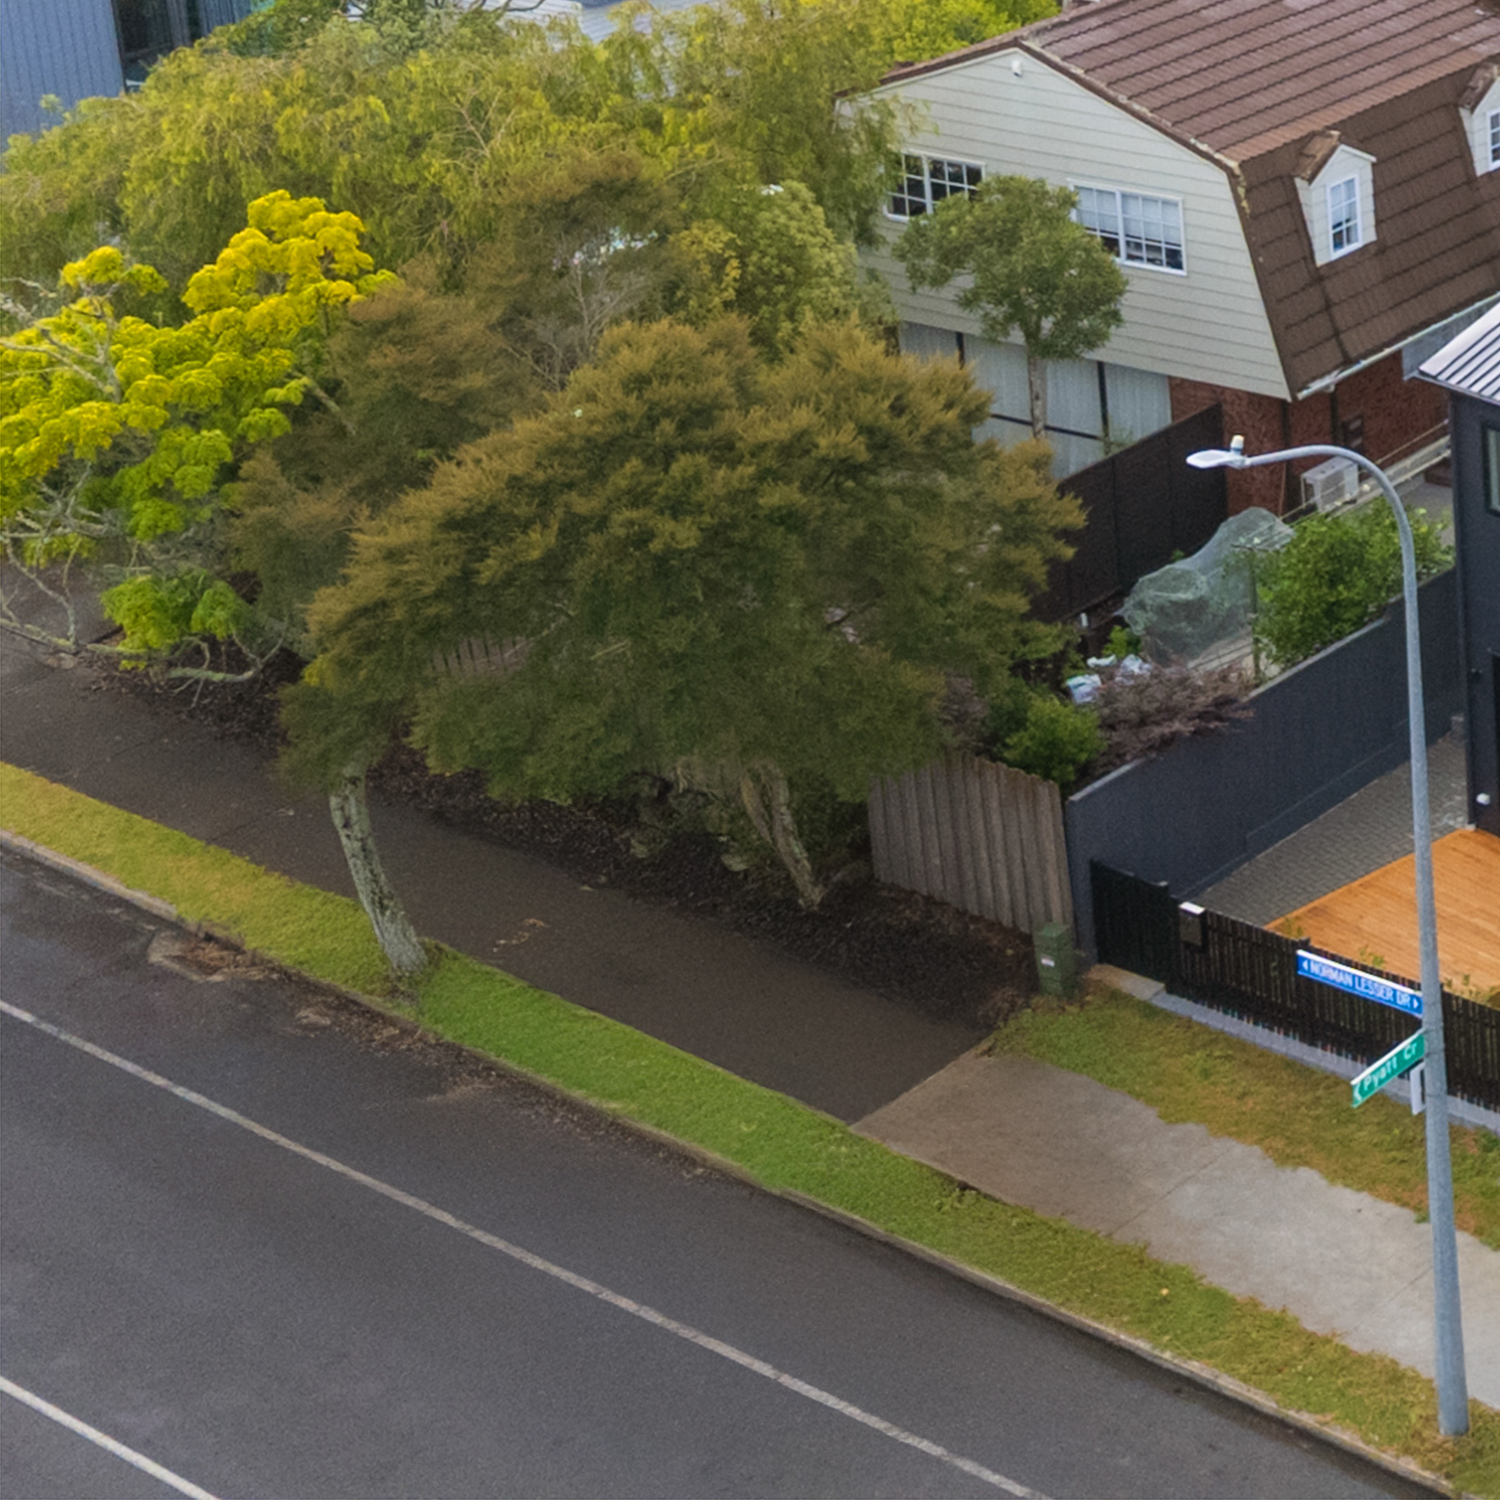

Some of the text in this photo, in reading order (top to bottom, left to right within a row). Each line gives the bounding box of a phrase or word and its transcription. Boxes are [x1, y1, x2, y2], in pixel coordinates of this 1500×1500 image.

[1310, 959, 1412, 1009] NORMAN LESSER DR
[1363, 1042, 1418, 1091] Pyatt Cr
